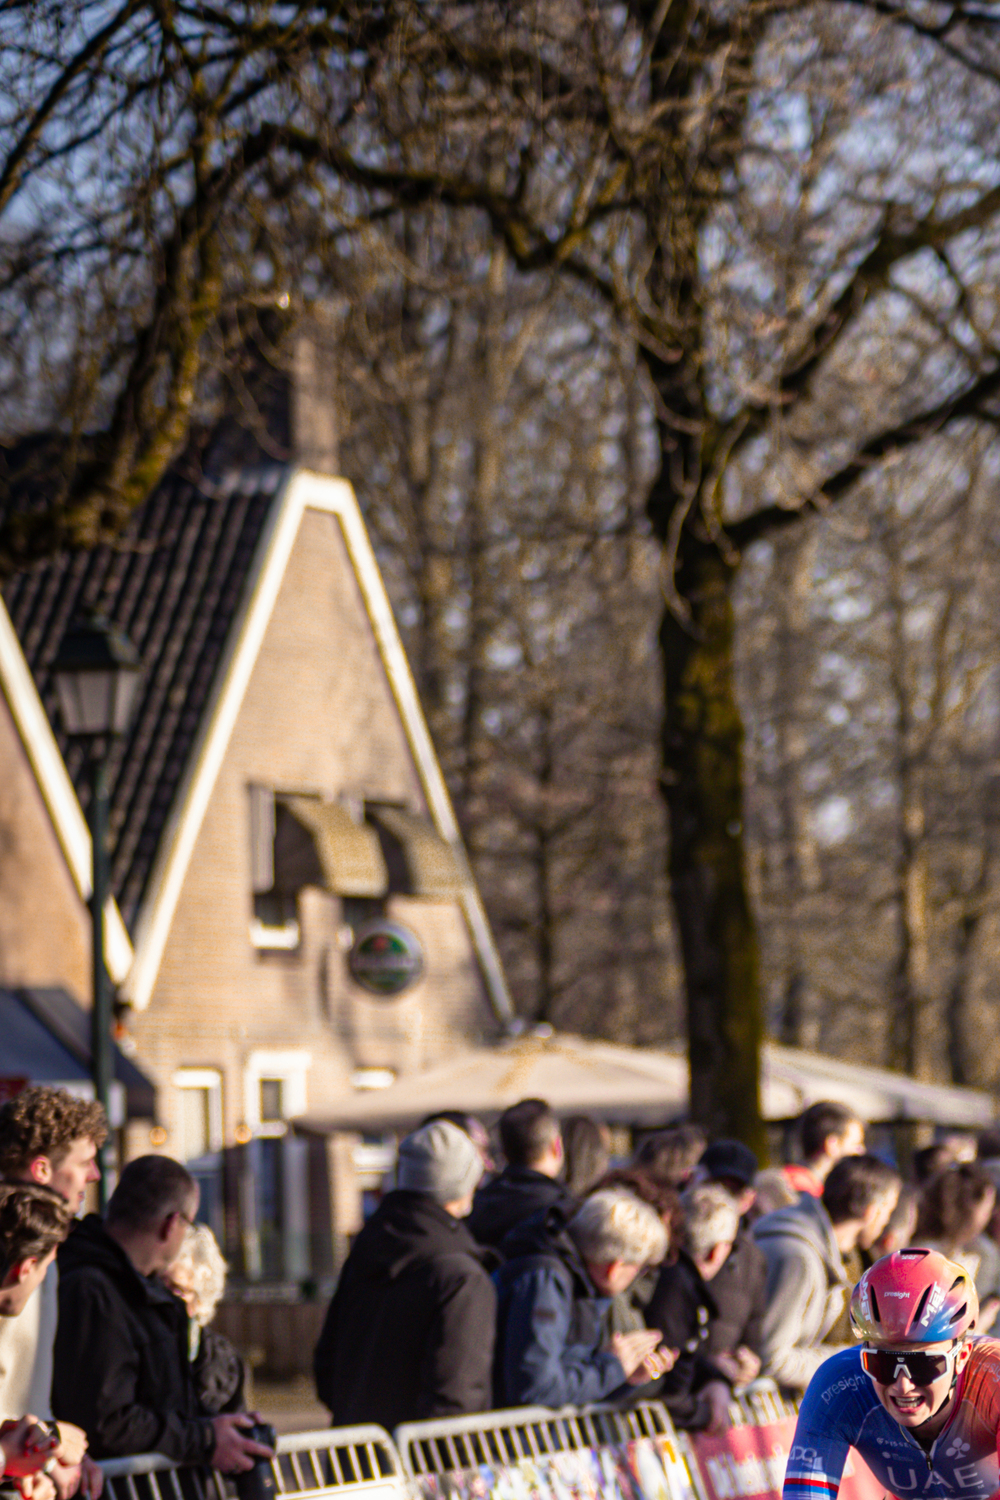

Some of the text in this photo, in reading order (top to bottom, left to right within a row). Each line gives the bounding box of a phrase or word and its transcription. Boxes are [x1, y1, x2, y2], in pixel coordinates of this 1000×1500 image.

[884, 1290, 910, 1299] presight
[920, 1281, 945, 1328] MET
[886, 1463, 984, 1491] UAE
